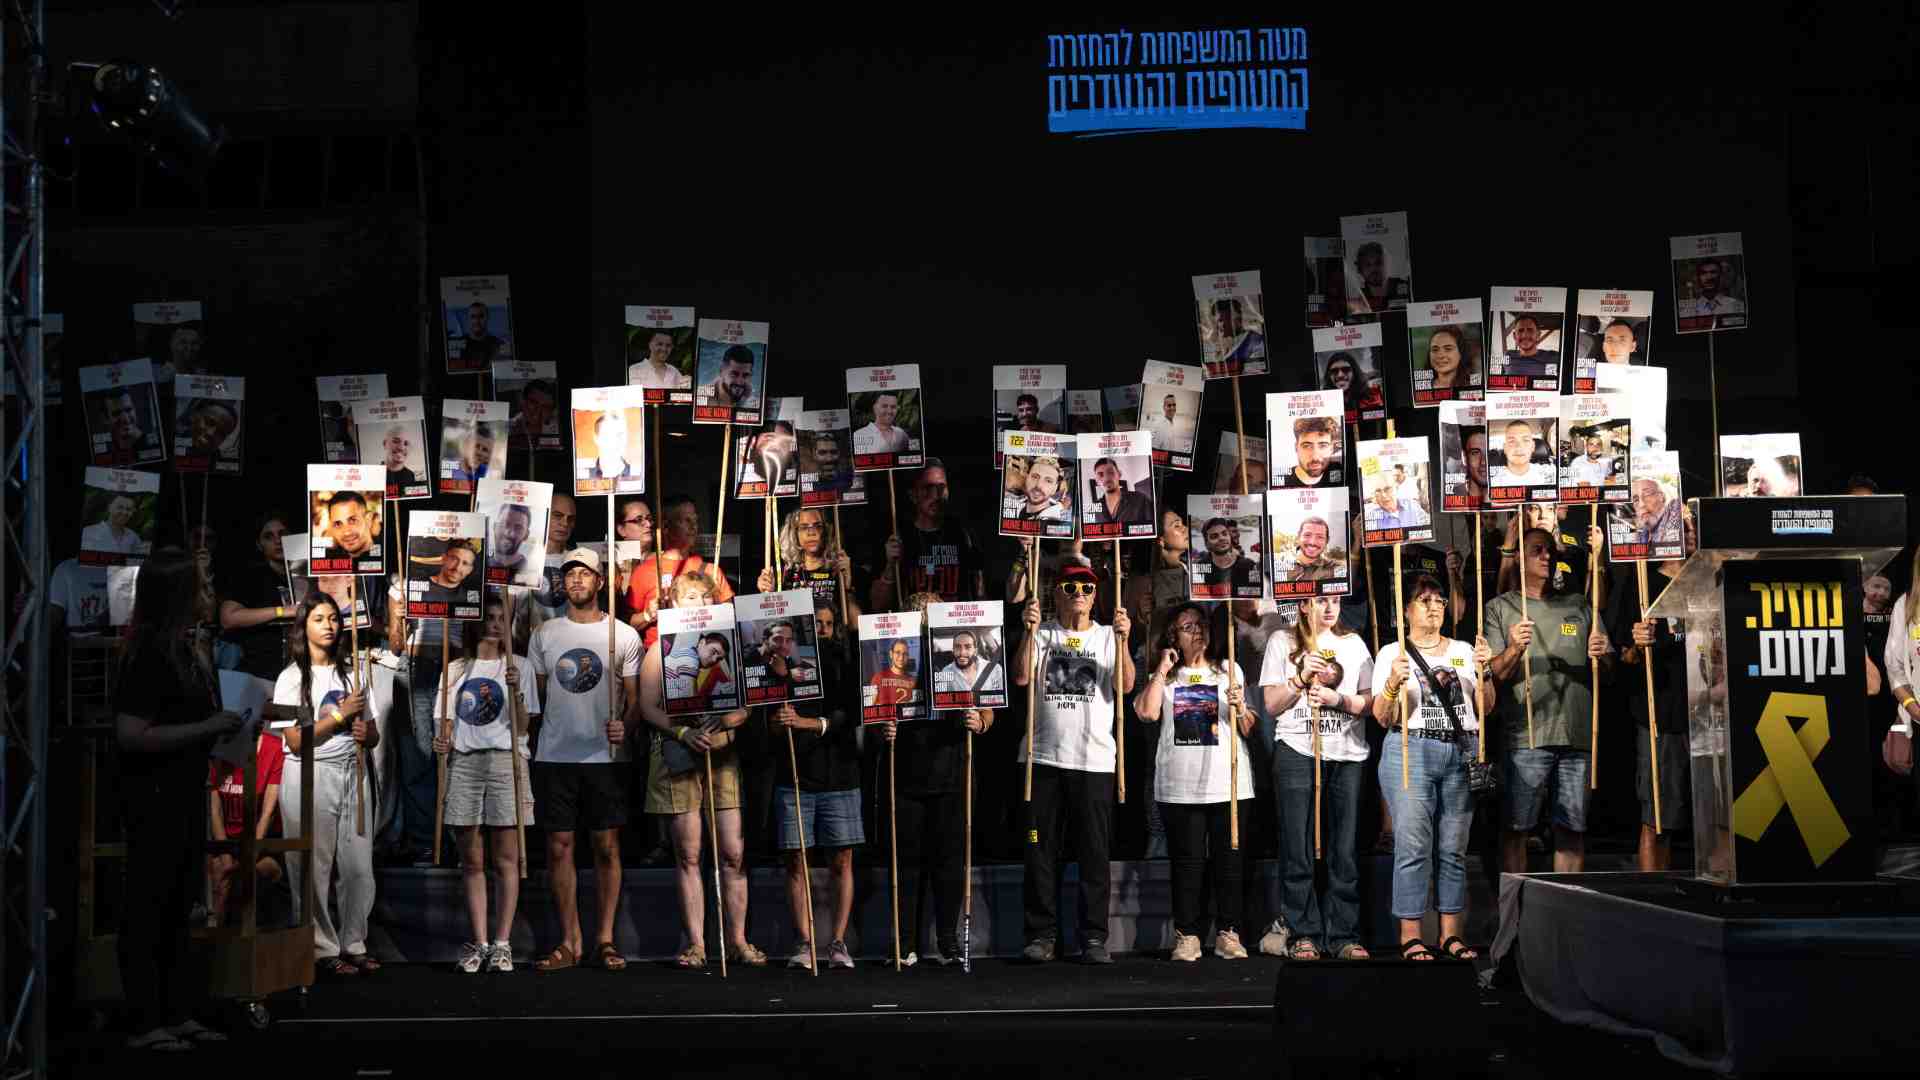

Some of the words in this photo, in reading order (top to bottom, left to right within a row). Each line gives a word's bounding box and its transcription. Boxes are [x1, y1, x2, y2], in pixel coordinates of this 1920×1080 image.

[1048, 28, 1134, 67] להחזרת
[1140, 28, 1252, 65] המשפחות
[1258, 27, 1308, 61] מטה
[1048, 72, 1176, 117] והנעדרים
[1186, 68, 1309, 113] החטופים
[1413, 369, 1434, 380] BRING
[1488, 376, 1505, 386] HOME
[1508, 376, 1527, 386] NOW!
[696, 407, 713, 418] HOME
[714, 407, 731, 418] NOW!
[1445, 473, 1466, 483] BRING
[1445, 484, 1455, 495] OZ
[1507, 486, 1525, 498] NOW!
[1560, 487, 1578, 498] HOME
[1579, 486, 1599, 498] NOW!
[1445, 496, 1465, 507] HOME
[1366, 530, 1383, 542] HOME
[1384, 528, 1403, 541] NOW!
[312, 559, 332, 570] HOME
[333, 559, 352, 570] NOW!
[1192, 564, 1212, 574] BRING
[409, 581, 430, 591] BRING
[1275, 583, 1295, 593] HOME
[1295, 580, 1315, 592] NOW!
[408, 602, 427, 614] HOME
[428, 602, 448, 614] NOW!
[1746, 582, 1843, 628] נחזיר.
[1748, 630, 1845, 683] נקום.
[745, 666, 766, 677] BRING
[934, 672, 954, 682] BRING
[746, 677, 760, 688] HIM
[1421, 708, 1443, 719] BRING
[1319, 719, 1342, 734] GAZA
[1425, 718, 1446, 729] HOME
